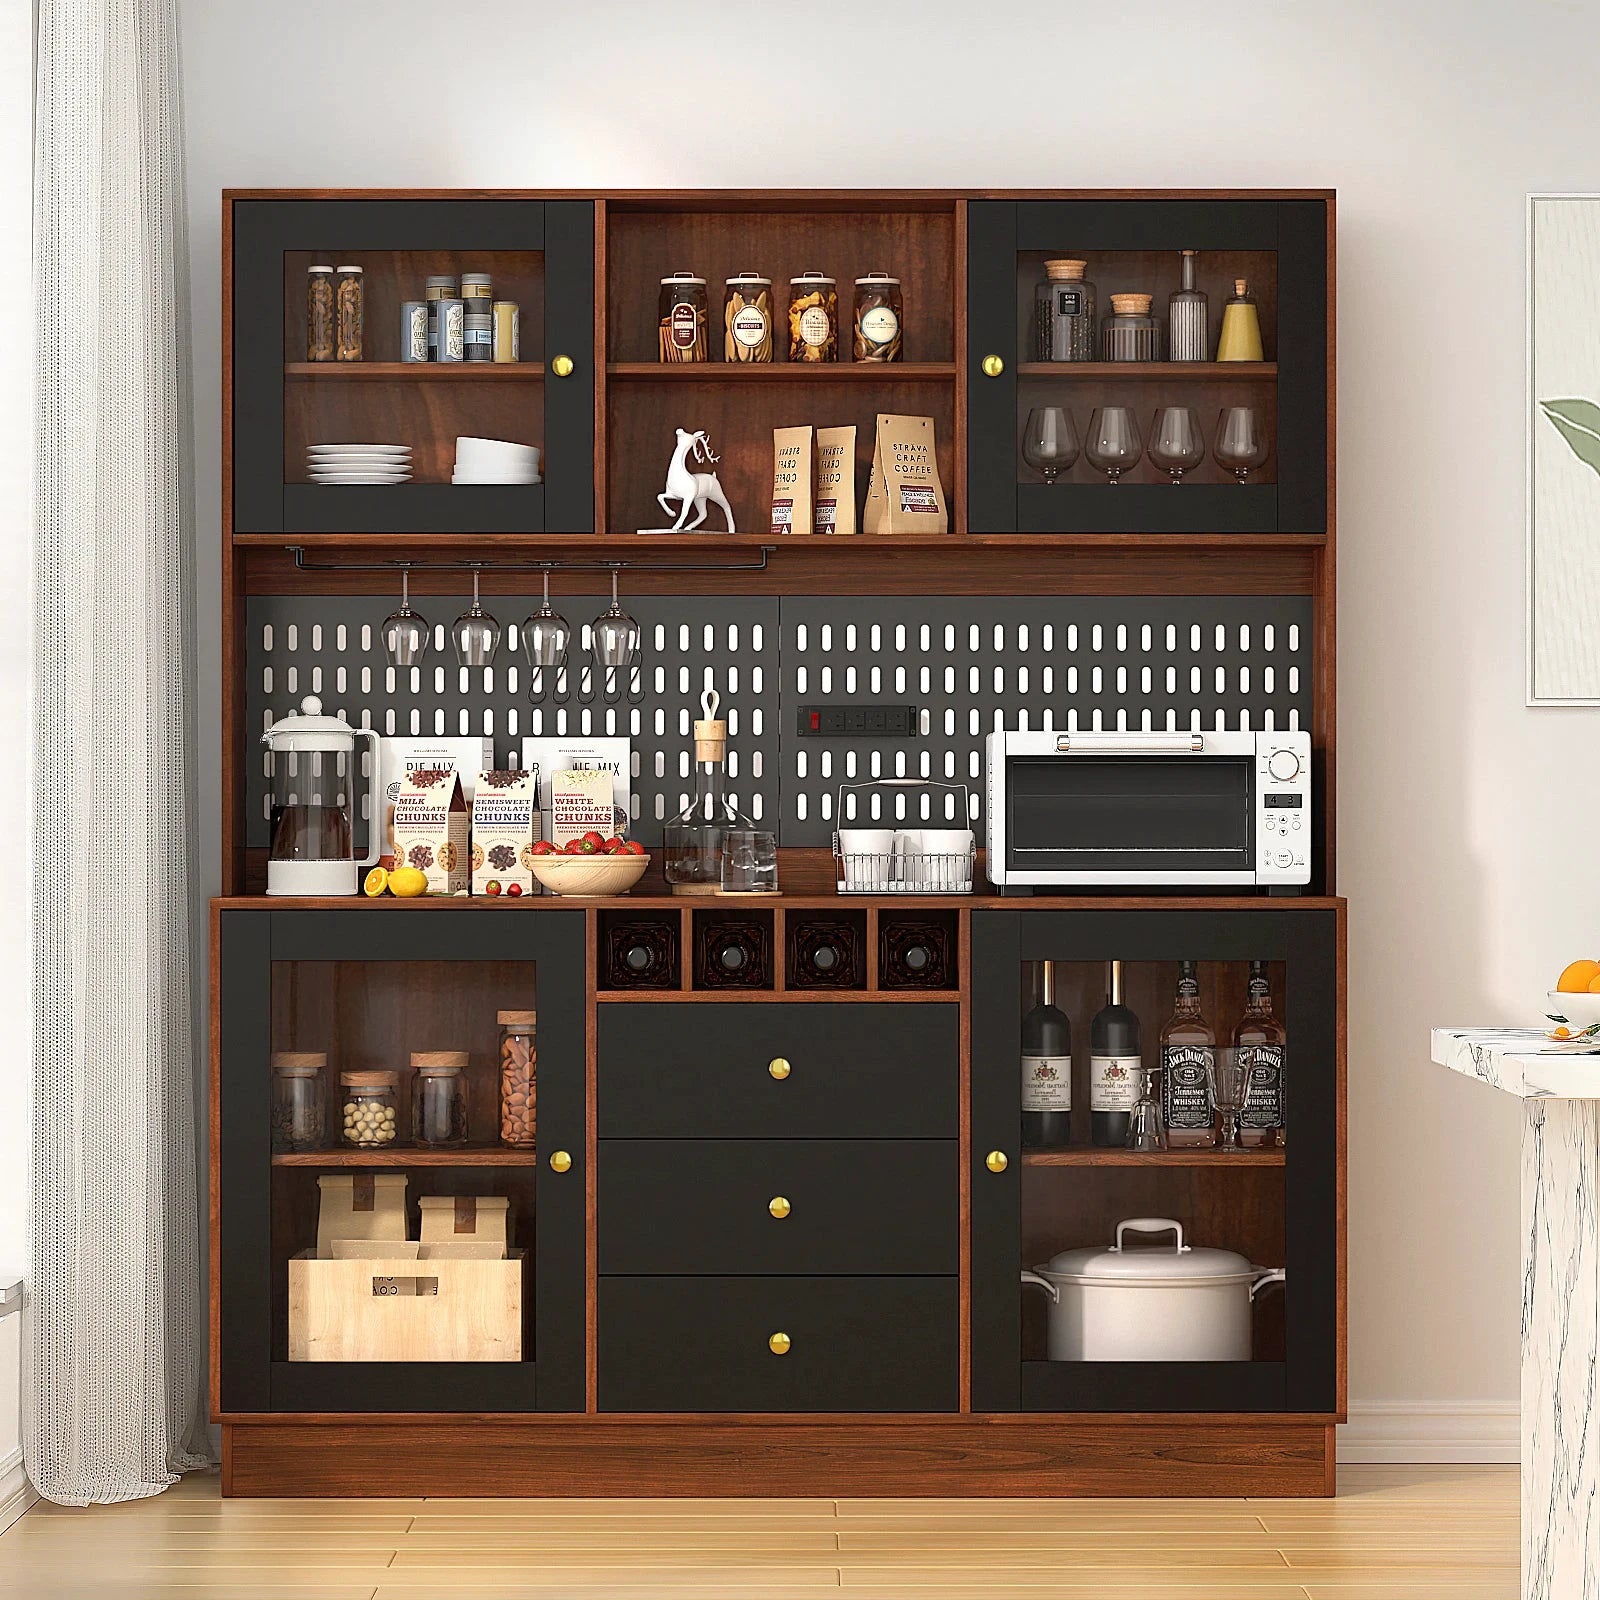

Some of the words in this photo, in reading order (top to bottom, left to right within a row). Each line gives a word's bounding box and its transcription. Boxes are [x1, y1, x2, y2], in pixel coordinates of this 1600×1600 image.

[896, 454, 927, 462] CRAFT
[894, 465, 932, 474] COFFEE
[598, 762, 620, 776] MIX
[1270, 795, 1277, 804] 4
[1288, 796, 1294, 804] 3
[396, 813, 446, 821] CHUNKS
[474, 813, 530, 821] CHUNKS
[1169, 1052, 1185, 1068] JACK
[1257, 1049, 1282, 1068] DANIEL'S
[1175, 1086, 1204, 1096] Tennessee
